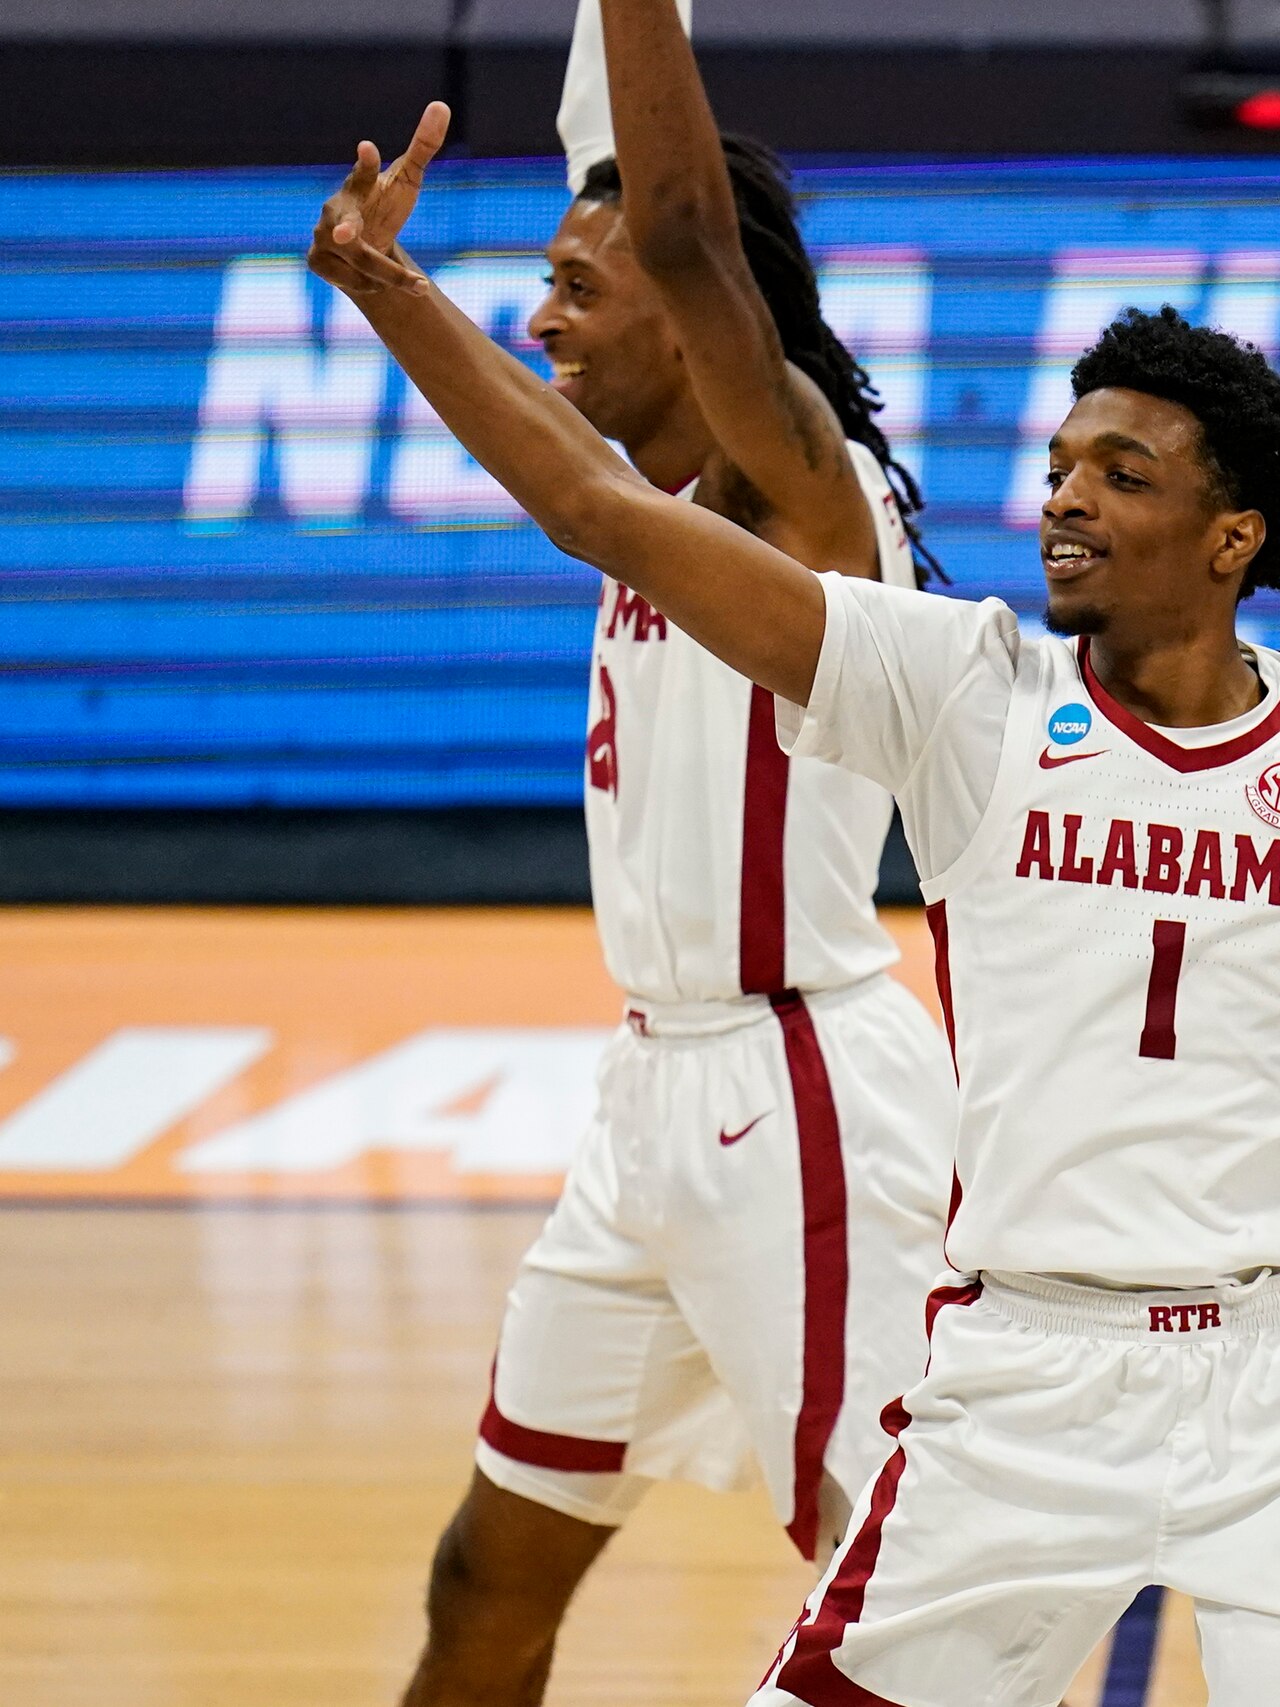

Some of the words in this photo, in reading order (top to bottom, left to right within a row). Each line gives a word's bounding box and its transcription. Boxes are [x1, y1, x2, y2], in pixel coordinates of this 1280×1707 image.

[183, 252, 930, 540] NC
[1052, 720, 1089, 735] NCAA
[1138, 918, 1187, 1060] 1
[1148, 1303, 1222, 1332] RTR
